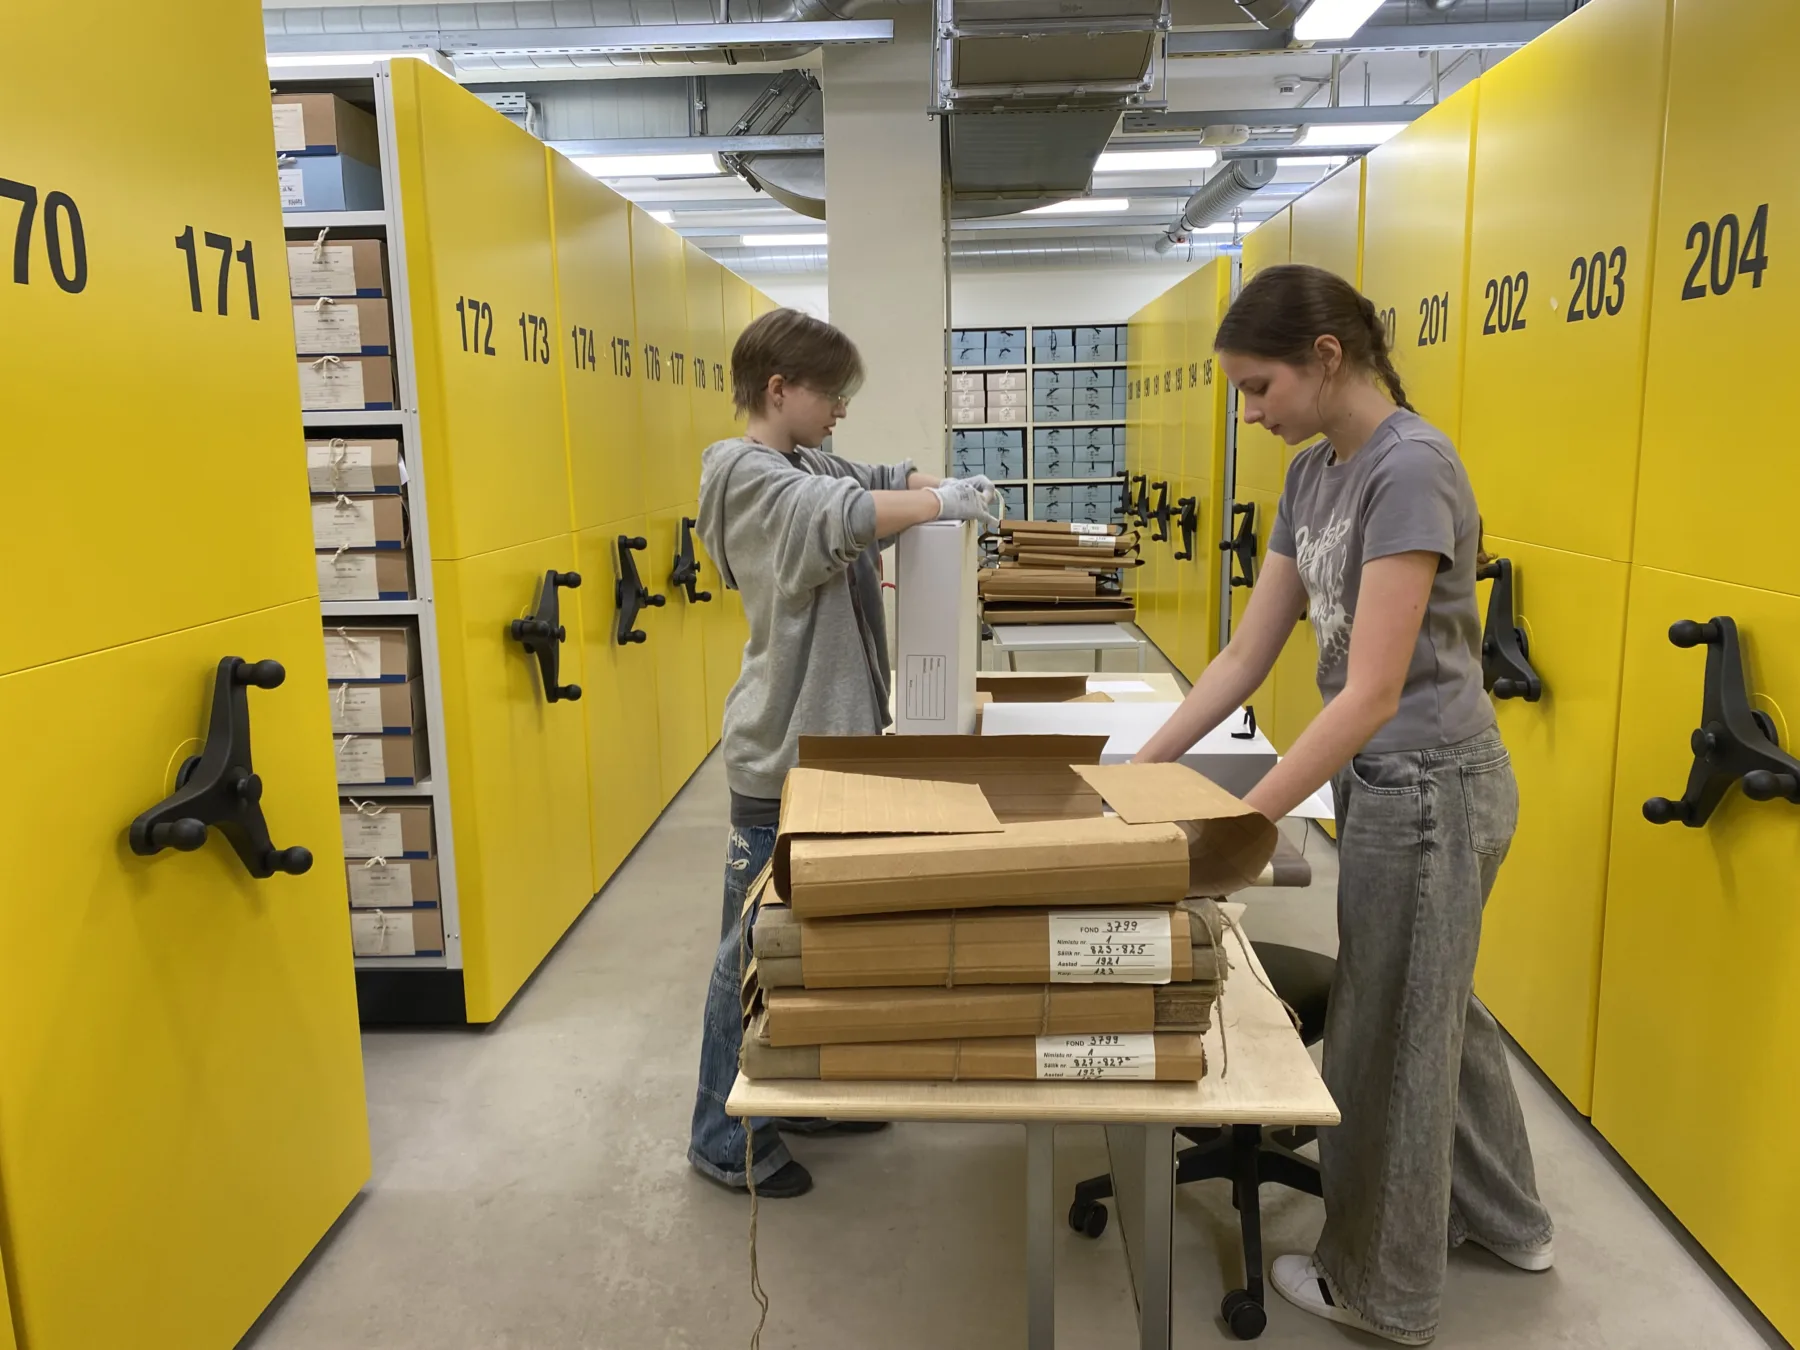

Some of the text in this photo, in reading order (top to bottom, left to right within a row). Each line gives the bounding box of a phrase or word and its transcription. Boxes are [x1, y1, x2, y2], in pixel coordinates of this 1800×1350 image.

[1681, 203, 1770, 302] 204
[174, 225, 260, 321] 171
[1566, 244, 1628, 323] 203
[1417, 291, 1450, 347] 201
[1482, 270, 1530, 336] 202
[456, 295, 497, 357] 172
[518, 312, 550, 365] 173
[571, 324, 596, 372] 174
[610, 336, 632, 378] 175
[644, 343, 661, 382] 176
[670, 351, 685, 386] 177
[693, 356, 707, 390] 178
[712, 362, 725, 393] 179
[1189, 362, 1197, 388] 194
[1203, 358, 1212, 386] 195
[1106, 920, 1138, 933] 3799
[1106, 935, 1112, 944] 1
[1093, 967, 1115, 976] 123
[1095, 956, 1120, 966] 1921
[1088, 1048, 1094, 1056] 1
[1090, 1035, 1119, 1046] 3799
[1077, 1067, 1104, 1077] 1927
